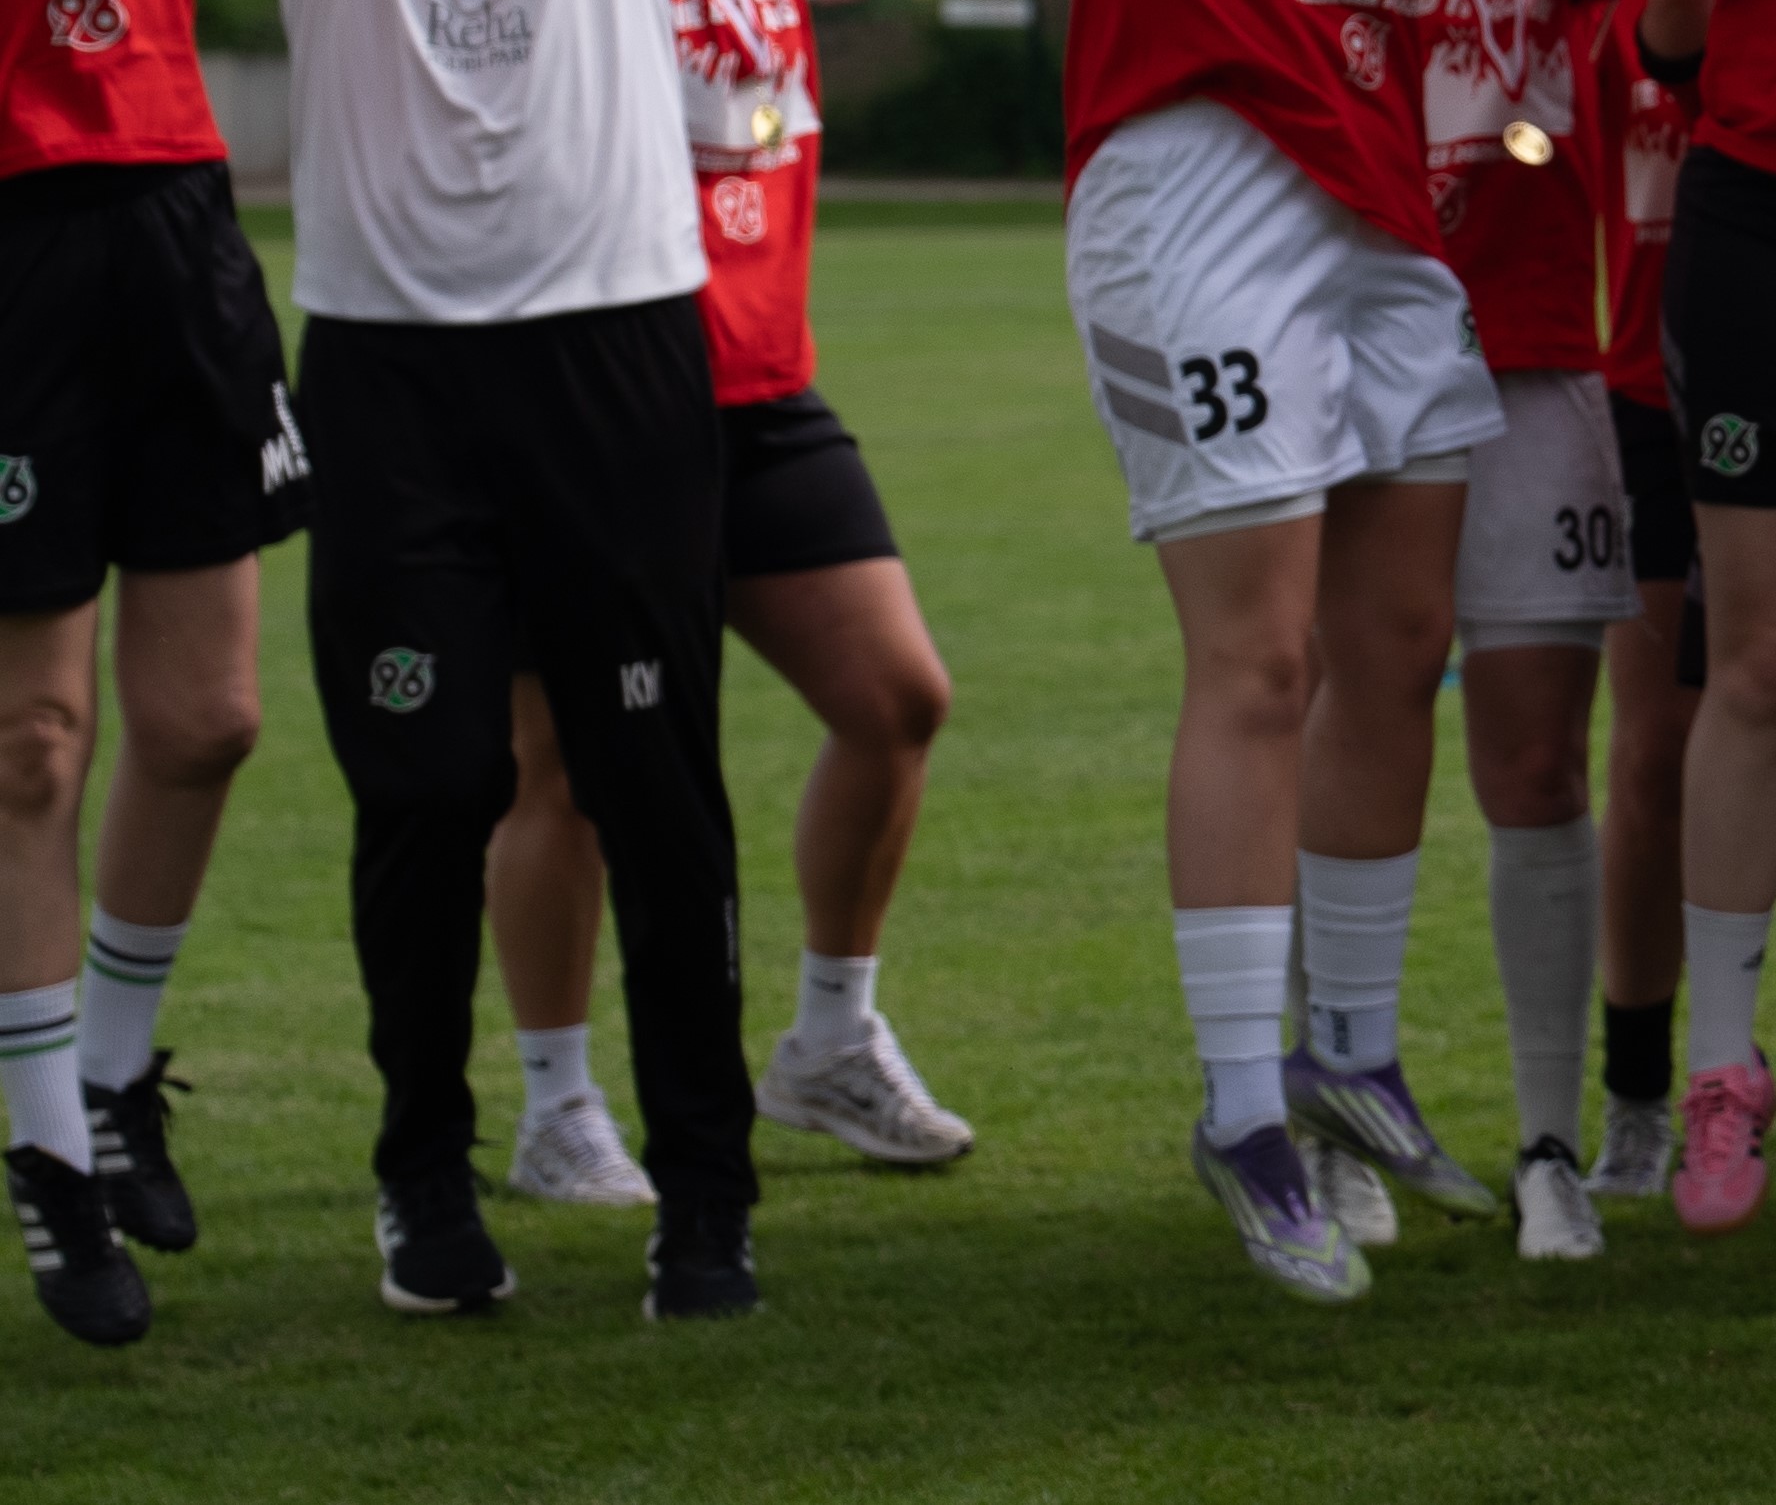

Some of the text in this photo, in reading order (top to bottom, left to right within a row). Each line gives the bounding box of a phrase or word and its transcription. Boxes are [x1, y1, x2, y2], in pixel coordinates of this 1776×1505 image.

[1181, 349, 1268, 442] 33
[1700, 412, 1761, 479] 96
[0, 453, 38, 527] 6
[1554, 505, 1613, 571] 30
[369, 646, 438, 715] 96
